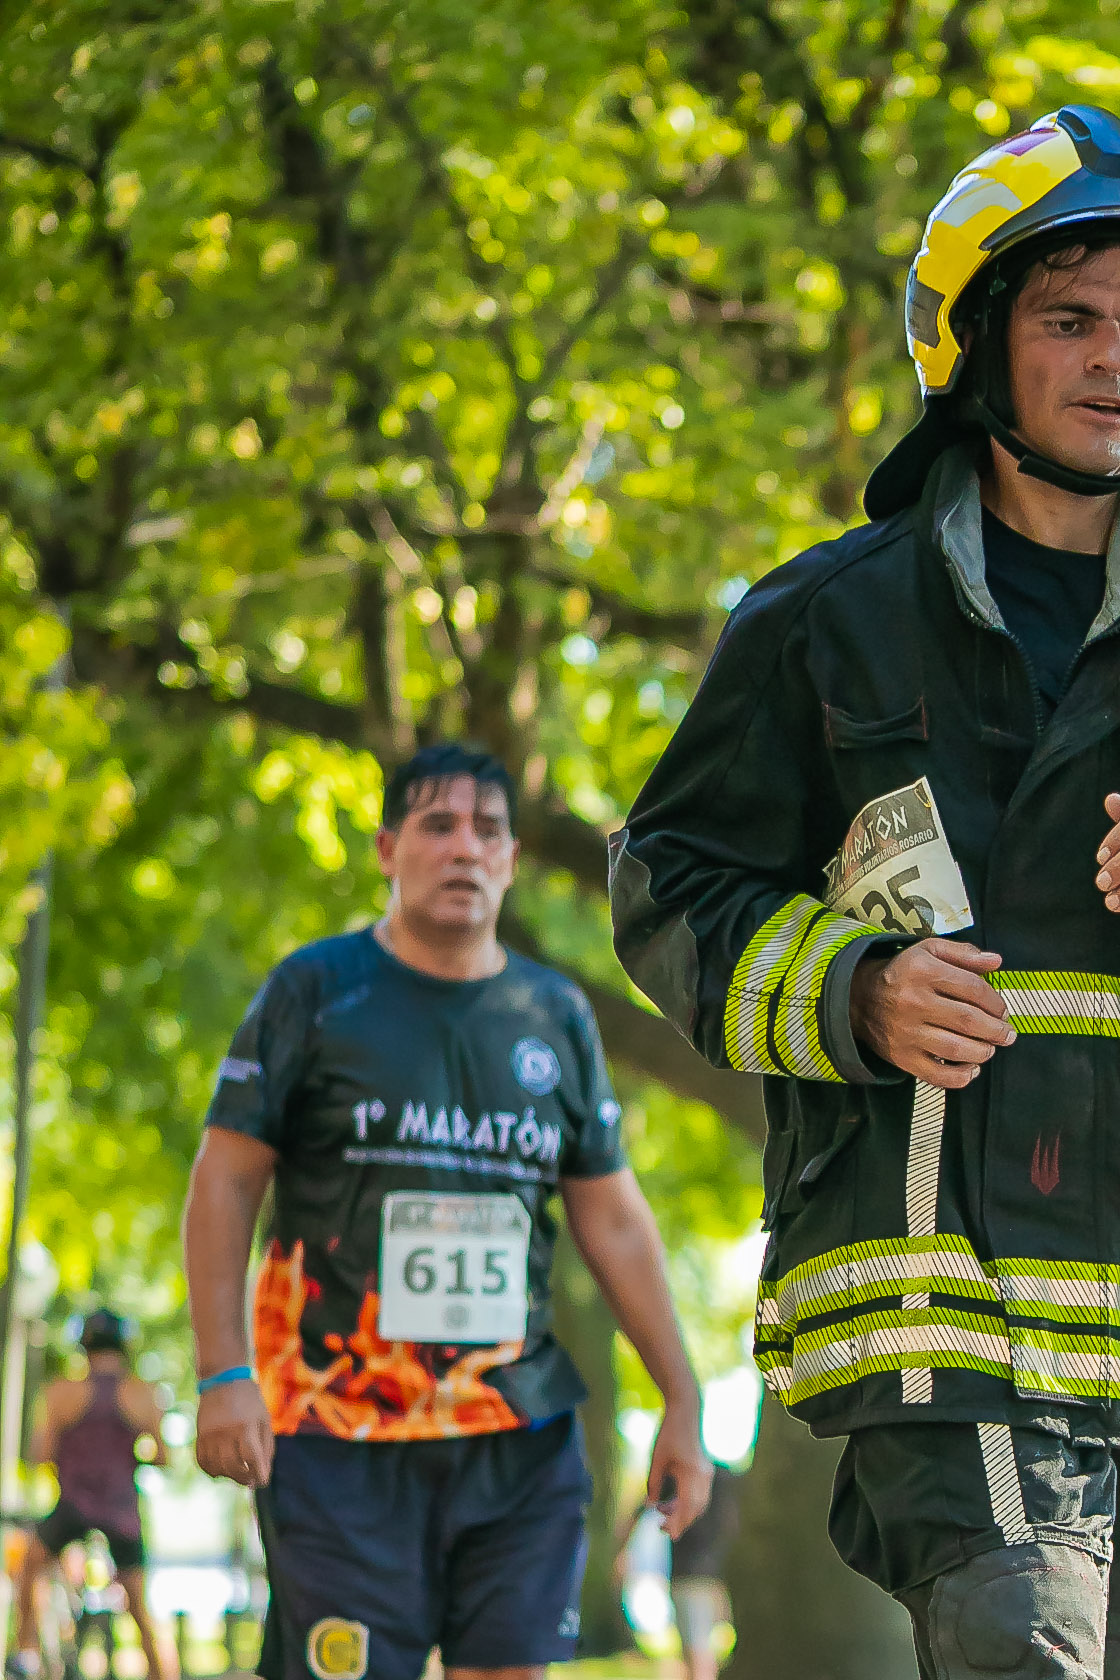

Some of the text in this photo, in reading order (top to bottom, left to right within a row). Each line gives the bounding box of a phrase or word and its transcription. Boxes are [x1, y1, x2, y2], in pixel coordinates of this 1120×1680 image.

[841, 805, 908, 875] MARATÓN
[899, 828, 934, 852] ROSARIO
[843, 865, 935, 936] 35
[397, 1099, 562, 1162] MARATÓN
[403, 1246, 509, 1296] 615
